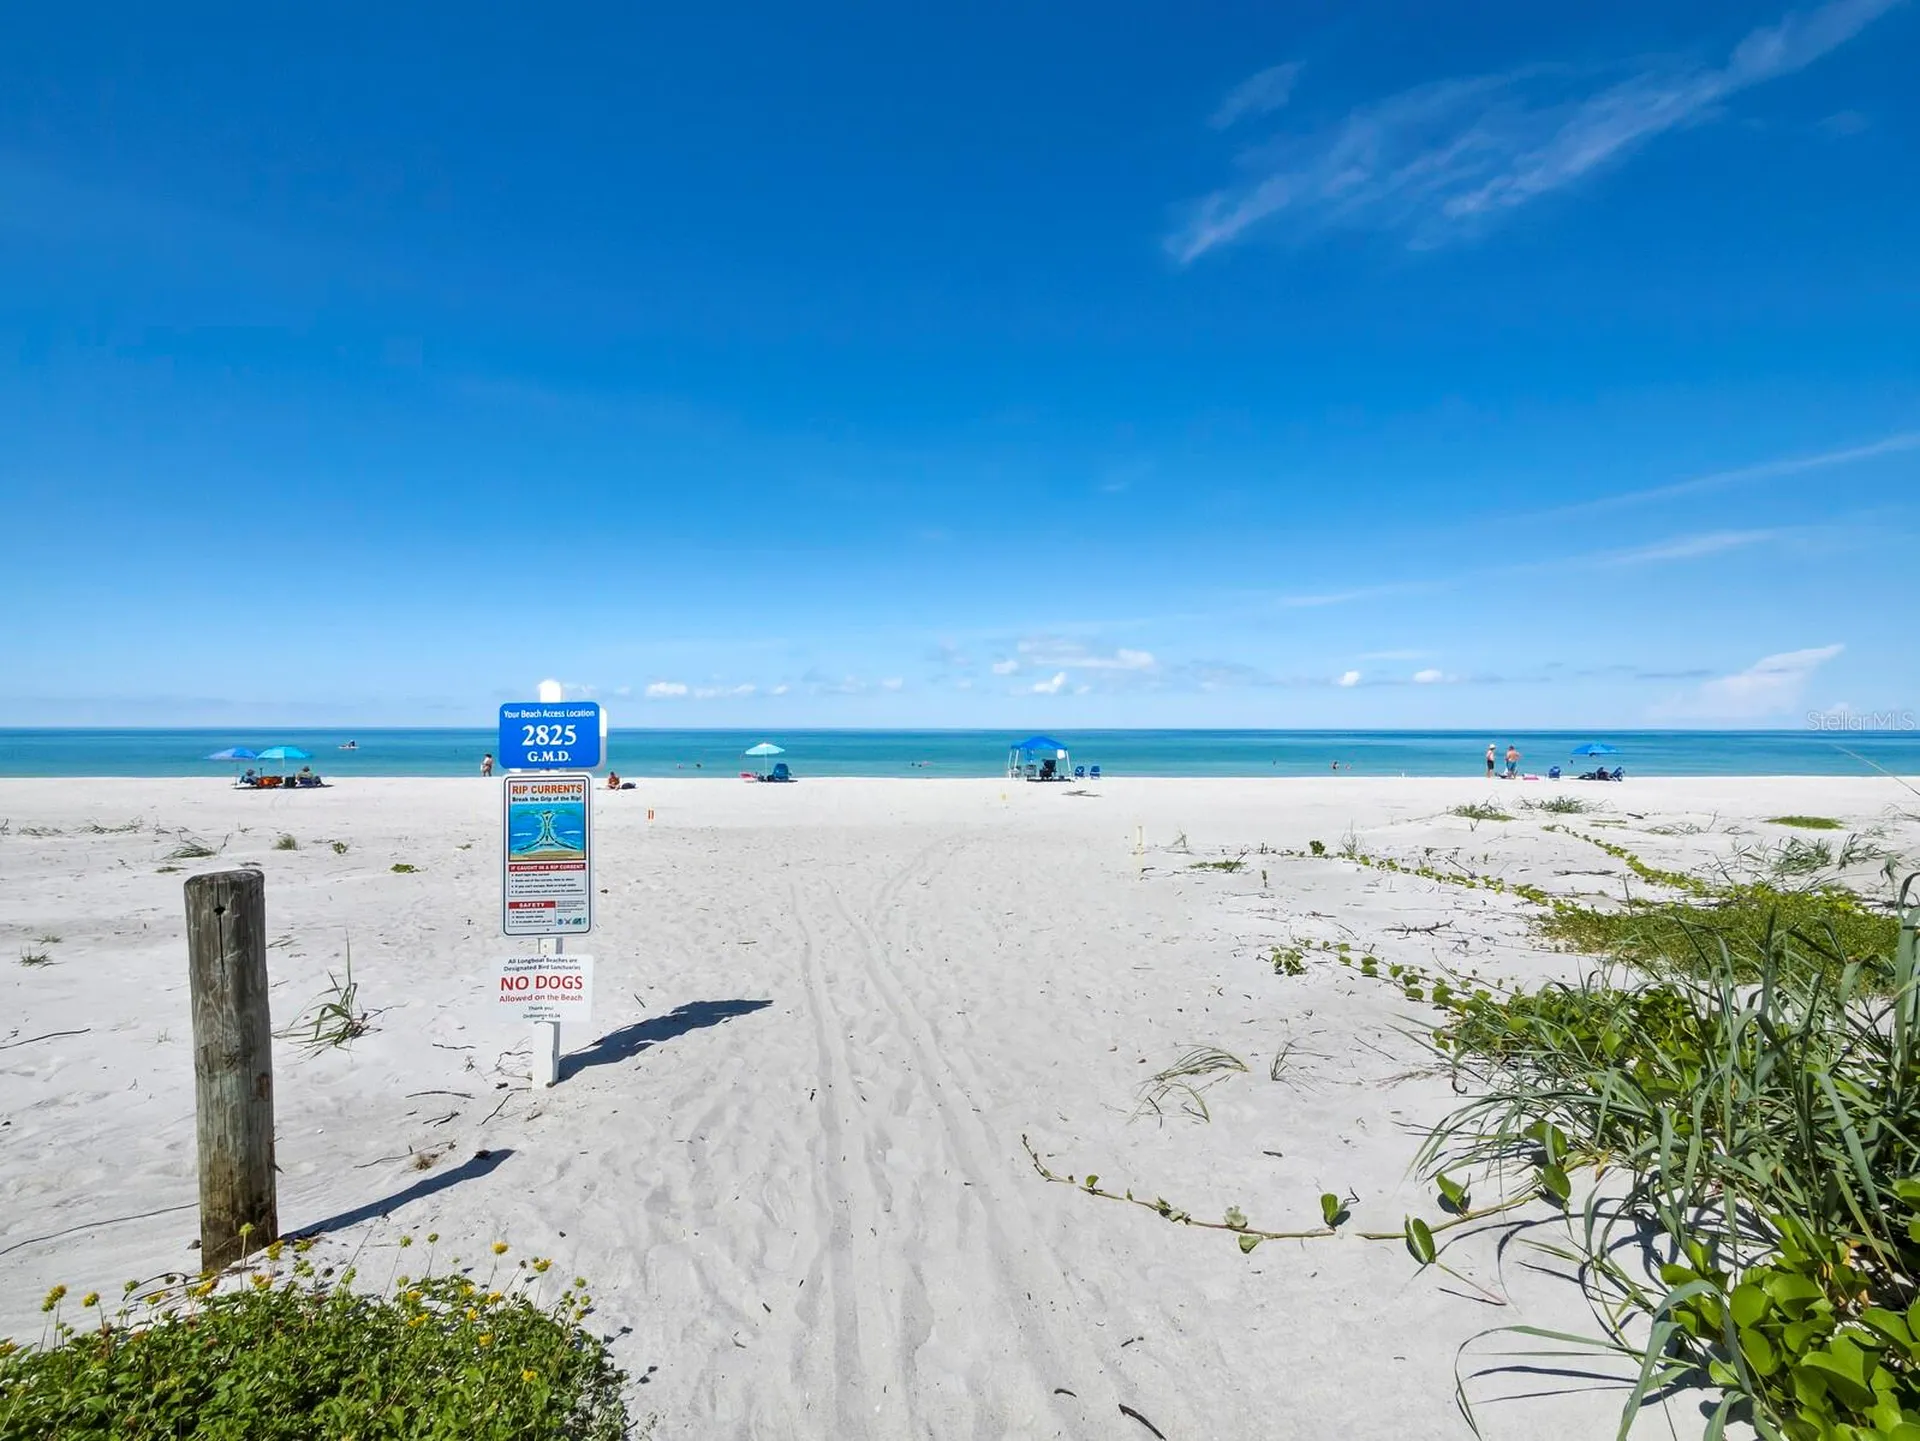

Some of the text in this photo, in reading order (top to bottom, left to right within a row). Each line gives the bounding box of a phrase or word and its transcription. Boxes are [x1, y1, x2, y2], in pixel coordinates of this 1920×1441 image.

[503, 708, 595, 719] Your Beach Access Location
[521, 724, 577, 746] 2825
[527, 750, 572, 763] G.M.D.
[512, 784, 583, 795] RIP CURRENTS
[500, 975, 583, 991] NO DOGS
[499, 994, 533, 1003] Allowed
